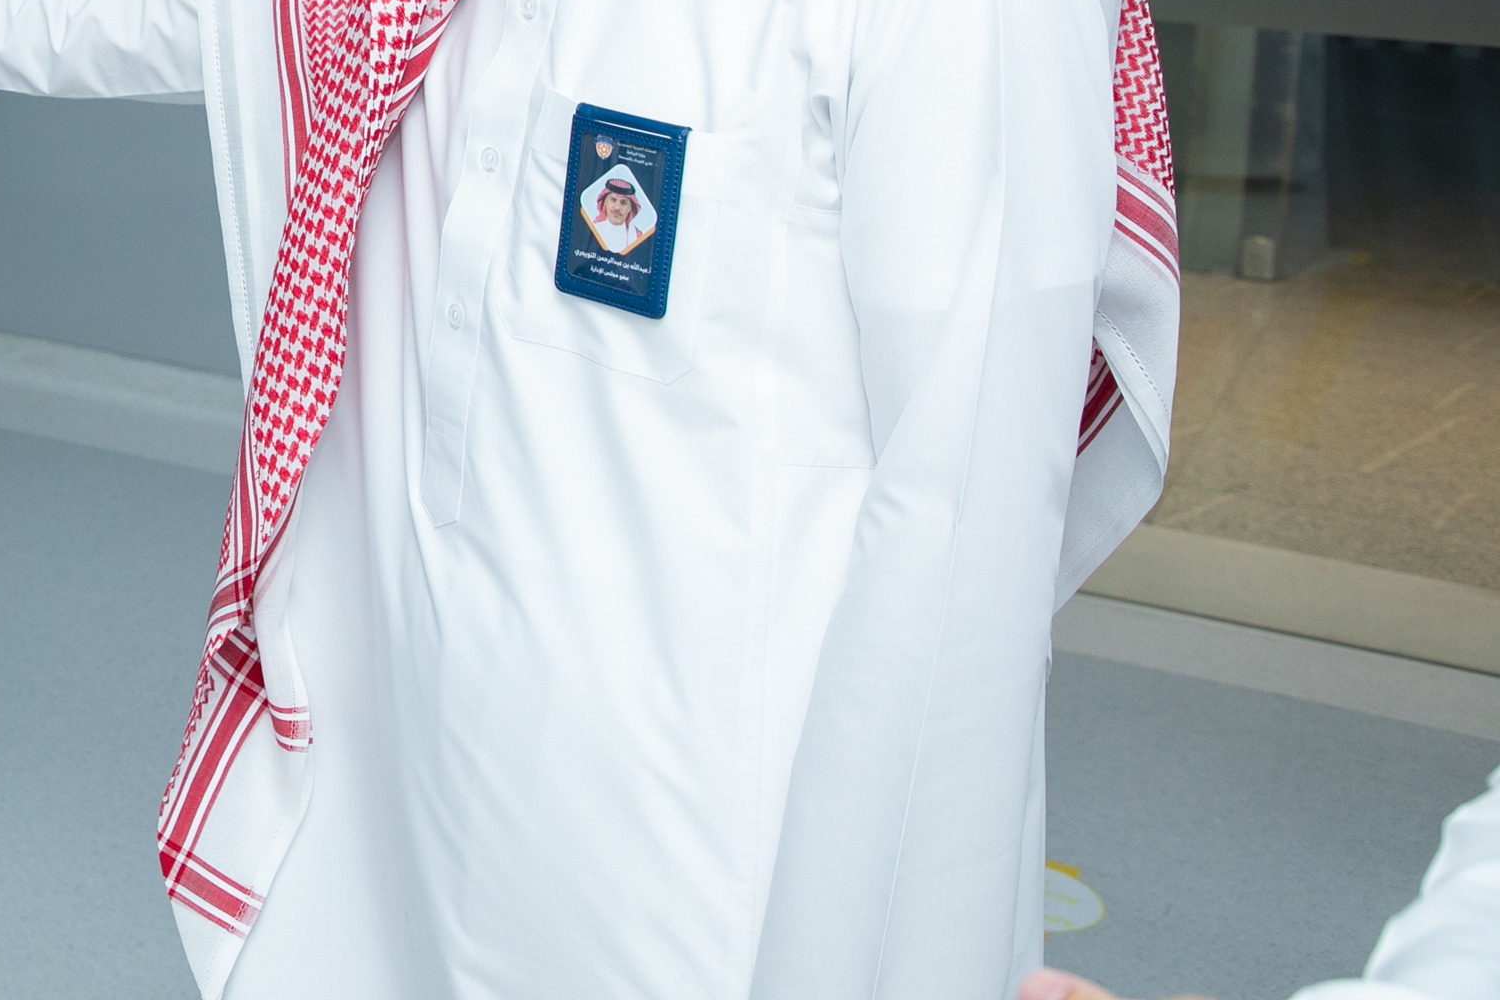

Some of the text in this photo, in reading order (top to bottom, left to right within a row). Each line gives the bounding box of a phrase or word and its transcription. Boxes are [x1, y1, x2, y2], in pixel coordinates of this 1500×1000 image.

[574, 249, 597, 259] التويجري
[596, 255, 622, 267] عبدالرحمن
[604, 270, 618, 278] مجلس
